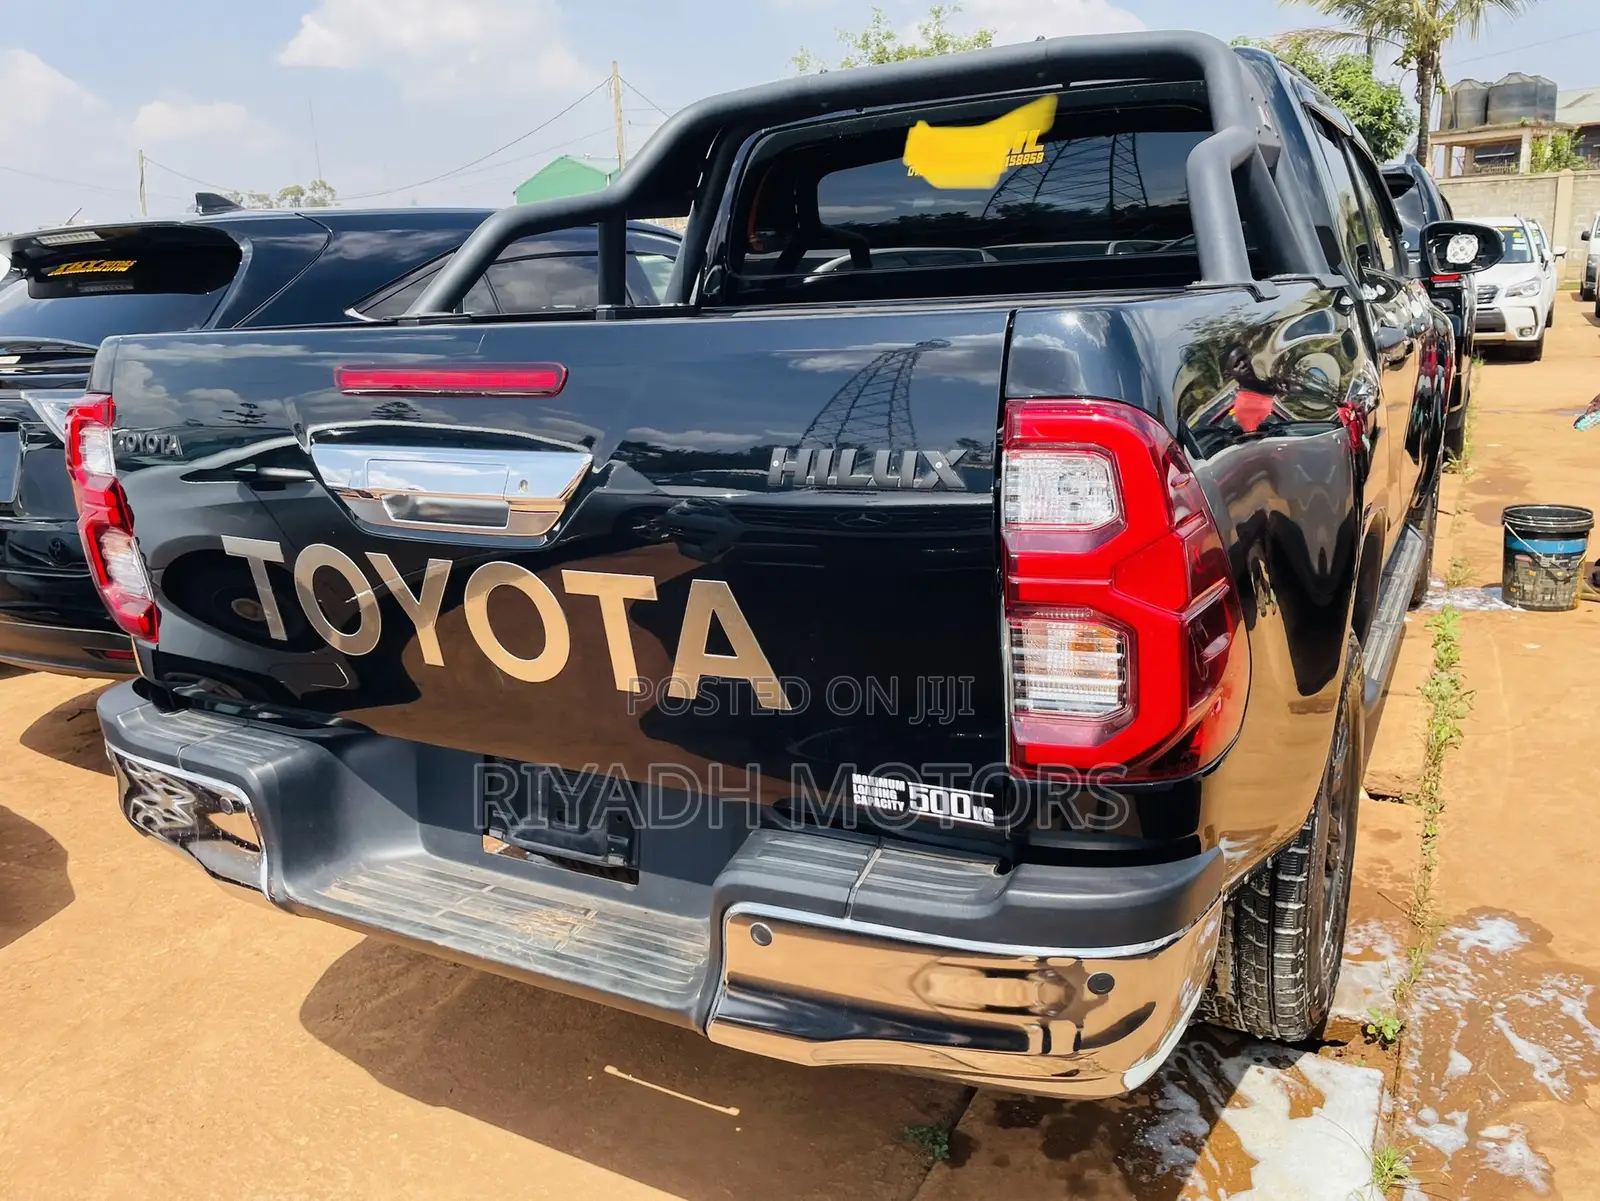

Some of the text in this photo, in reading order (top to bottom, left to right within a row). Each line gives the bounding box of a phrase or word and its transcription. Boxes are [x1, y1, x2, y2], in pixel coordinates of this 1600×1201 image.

[116, 432, 184, 456] TOYOTA
[767, 447, 968, 491] HILUX
[221, 535, 792, 710] TOYOTA
[852, 773, 906, 791] MAXIMUM
[852, 783, 898, 799] LOADING
[853, 794, 905, 812] CAPACITY
